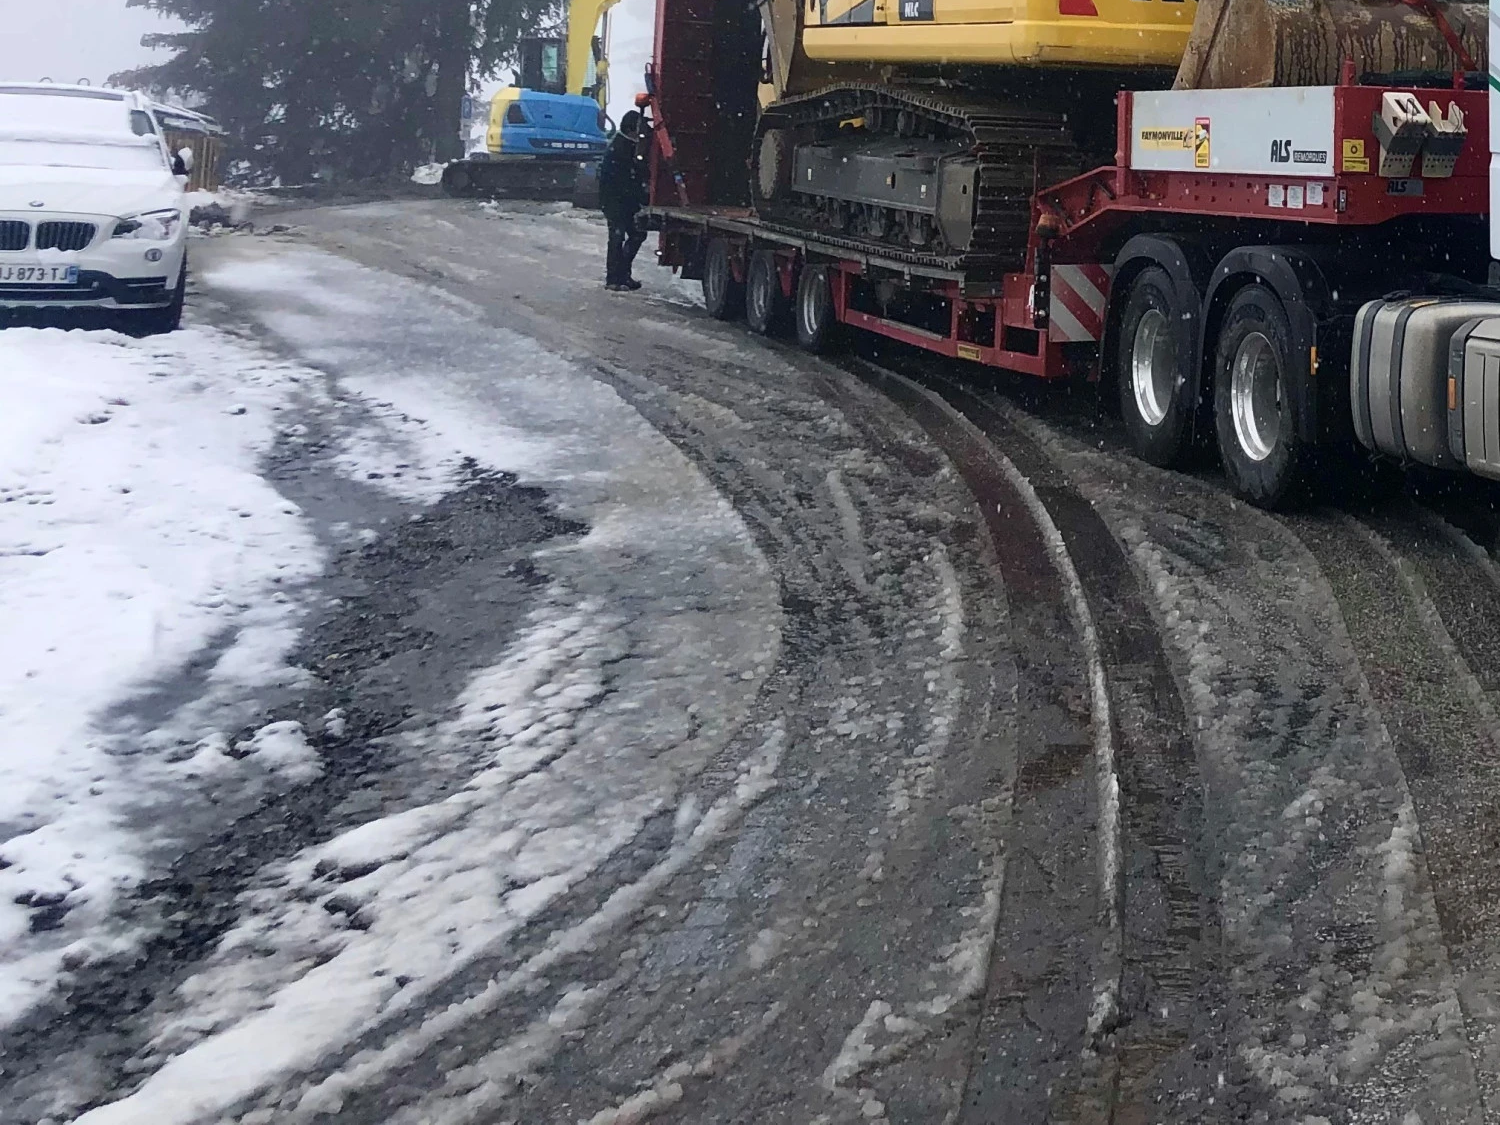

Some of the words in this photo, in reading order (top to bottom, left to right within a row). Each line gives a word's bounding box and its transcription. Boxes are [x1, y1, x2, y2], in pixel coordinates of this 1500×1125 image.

[904, 2, 919, 17] NLC
[1141, 130, 1184, 141] FAYMONVILLE
[1270, 139, 1291, 163] ALS
[1387, 180, 1408, 193] ALS
[0, 267, 68, 281] J-873-TJ
